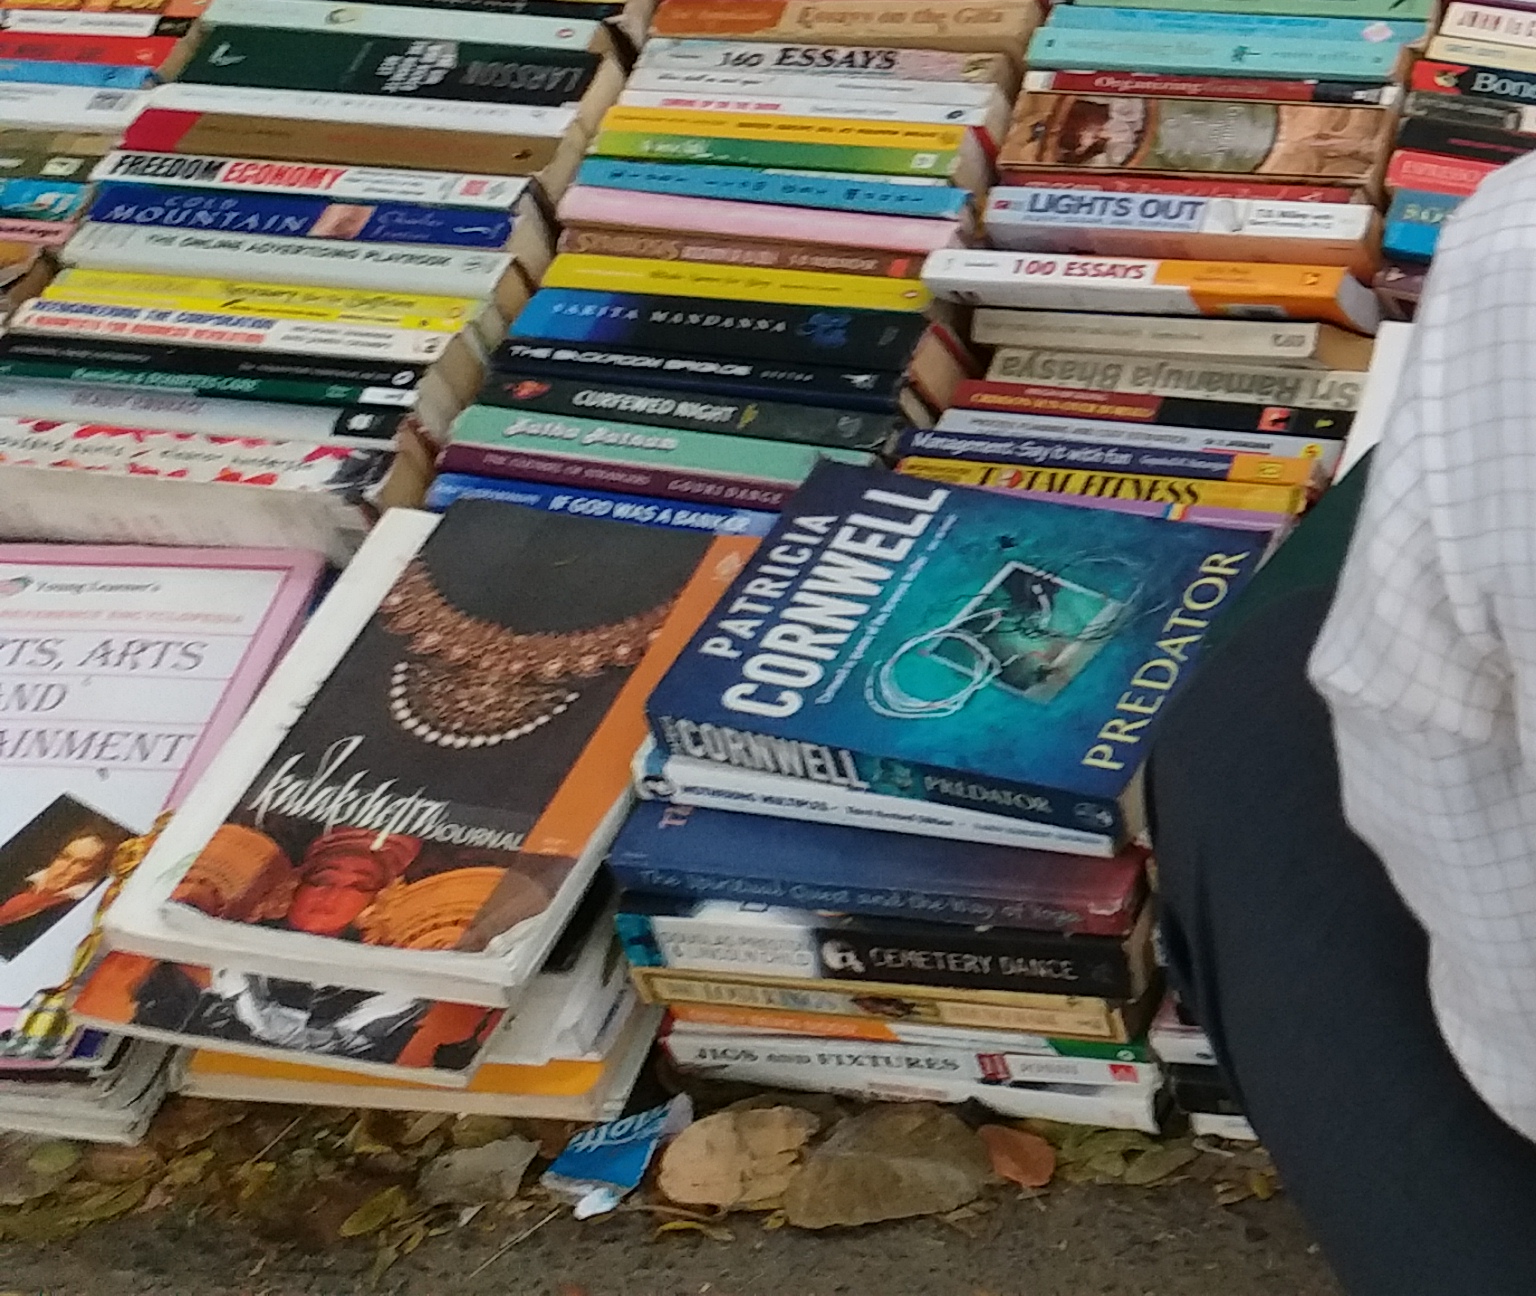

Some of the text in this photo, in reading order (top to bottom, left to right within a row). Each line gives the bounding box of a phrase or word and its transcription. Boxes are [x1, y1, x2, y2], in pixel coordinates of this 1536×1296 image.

[719, 46, 897, 71] 160 ESSAYS
[110, 152, 349, 191] FREEDOM ECONOMY
[104, 203, 308, 234] MOUNTAIN
[1029, 192, 1205, 221] LIGHTS OUT
[1012, 257, 1147, 280] 100 ESSAYS
[508, 343, 552, 358] THE
[1000, 349, 1120, 389] Bhasya
[1128, 364, 1304, 404] Ramanuja
[1080, 471, 1200, 505] FITNESS
[567, 496, 612, 517] GOD
[611, 503, 657, 522] WAS
[698, 512, 841, 661] PATRICIA
[720, 486, 953, 720] CORNWELL
[77, 637, 208, 673] ARTS
[1081, 547, 1252, 772] PREDATOR
[682, 718, 872, 794] CORNWELL
[922, 773, 1055, 819] PREDATOR
[431, 818, 524, 853] JOURNAL
[867, 944, 1080, 981] CEMETERY DANCE
[816, 1052, 961, 1072] FIXTURES
